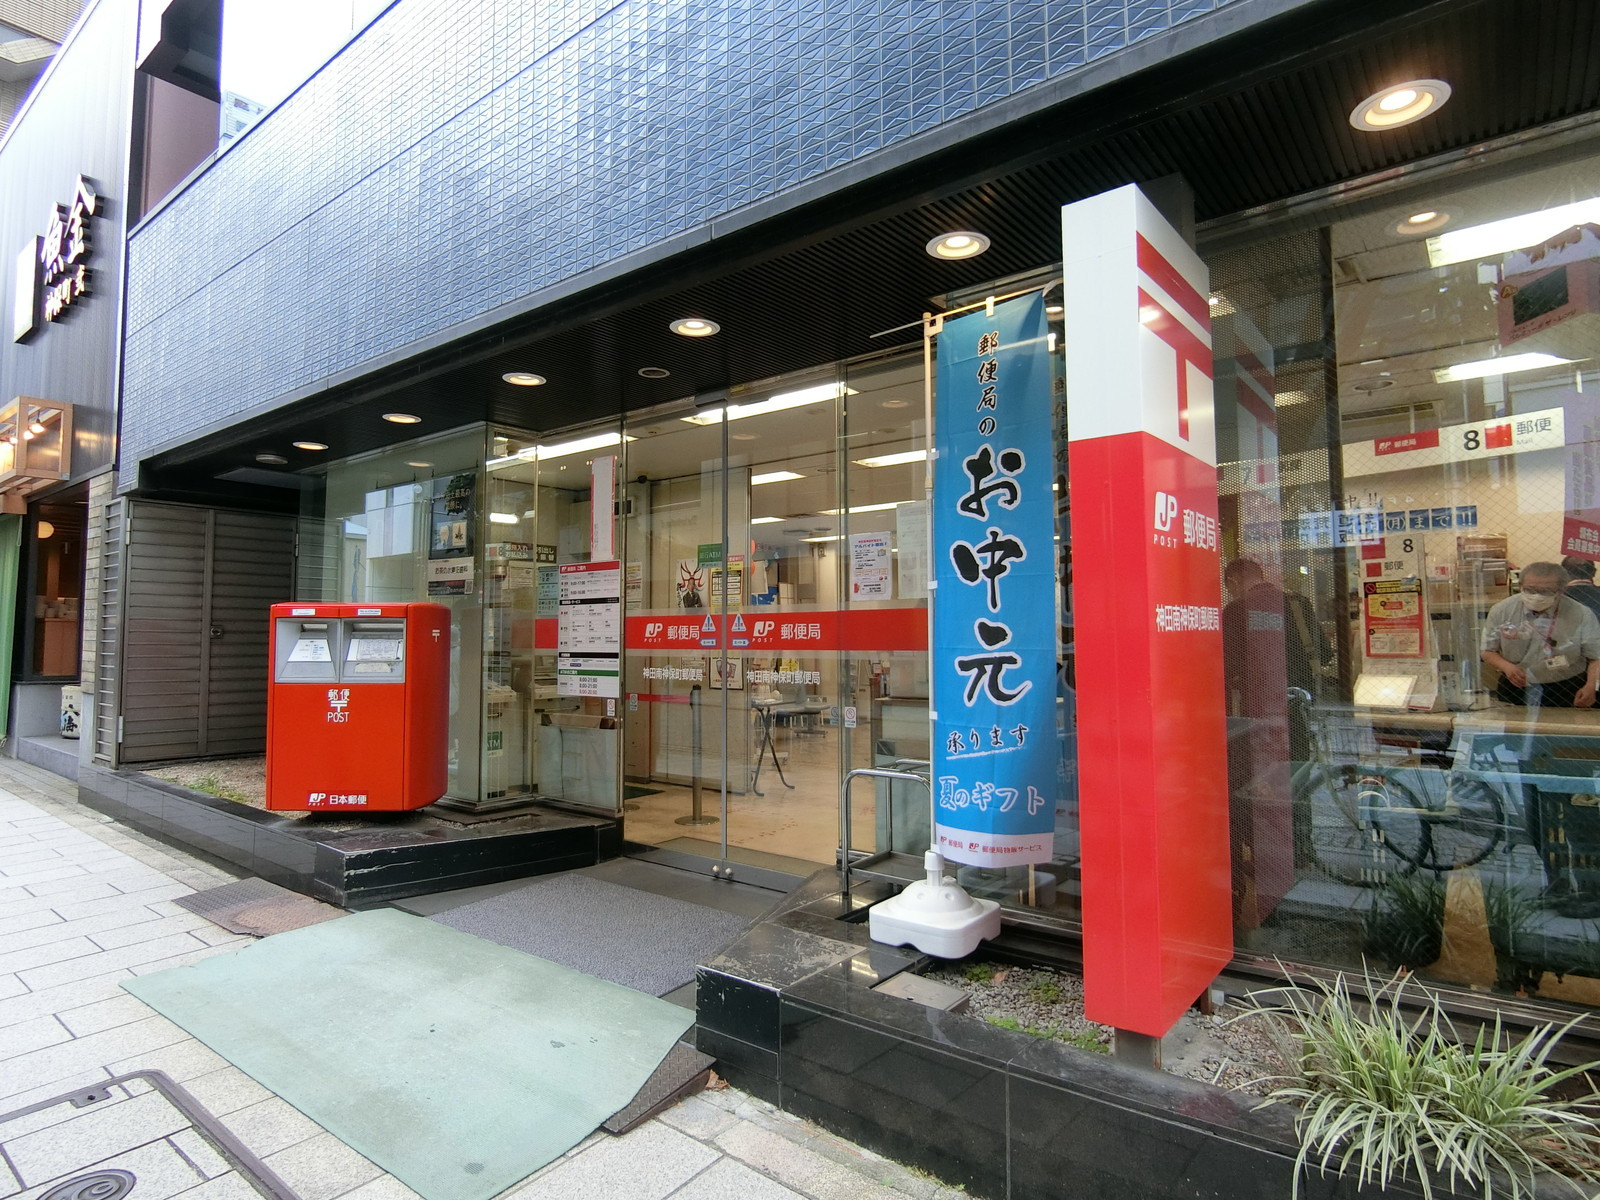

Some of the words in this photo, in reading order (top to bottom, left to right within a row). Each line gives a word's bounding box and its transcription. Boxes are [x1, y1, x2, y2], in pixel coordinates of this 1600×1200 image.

[976, 330, 999, 436] 郵便局の
[1463, 430, 1480, 451] 8
[1516, 417, 1552, 436] 郵便
[1394, 438, 1417, 447] 郵便局
[1183, 508, 1217, 552] 郵便局
[1153, 533, 1177, 549] POST
[1403, 538, 1413, 552] 8
[1384, 560, 1404, 571] 郵便
[950, 443, 1033, 708] お中元
[1155, 603, 1220, 632] 神田南神保町郵便局
[667, 625, 700, 640] 郵便局
[780, 623, 821, 640] 郵便局
[643, 667, 703, 682] 神田南神保町郵便局
[746, 670, 821, 685] 神田南神保町郵便局
[327, 688, 351, 701] 郵便
[327, 712, 350, 722] POST
[947, 723, 1029, 754] 承ります
[329, 794, 368, 805] 日本郵便
[939, 775, 1045, 815] 夏のギフト
[948, 838, 963, 849] 郵便局
[982, 844, 1042, 854] 郵便局物販サービス
